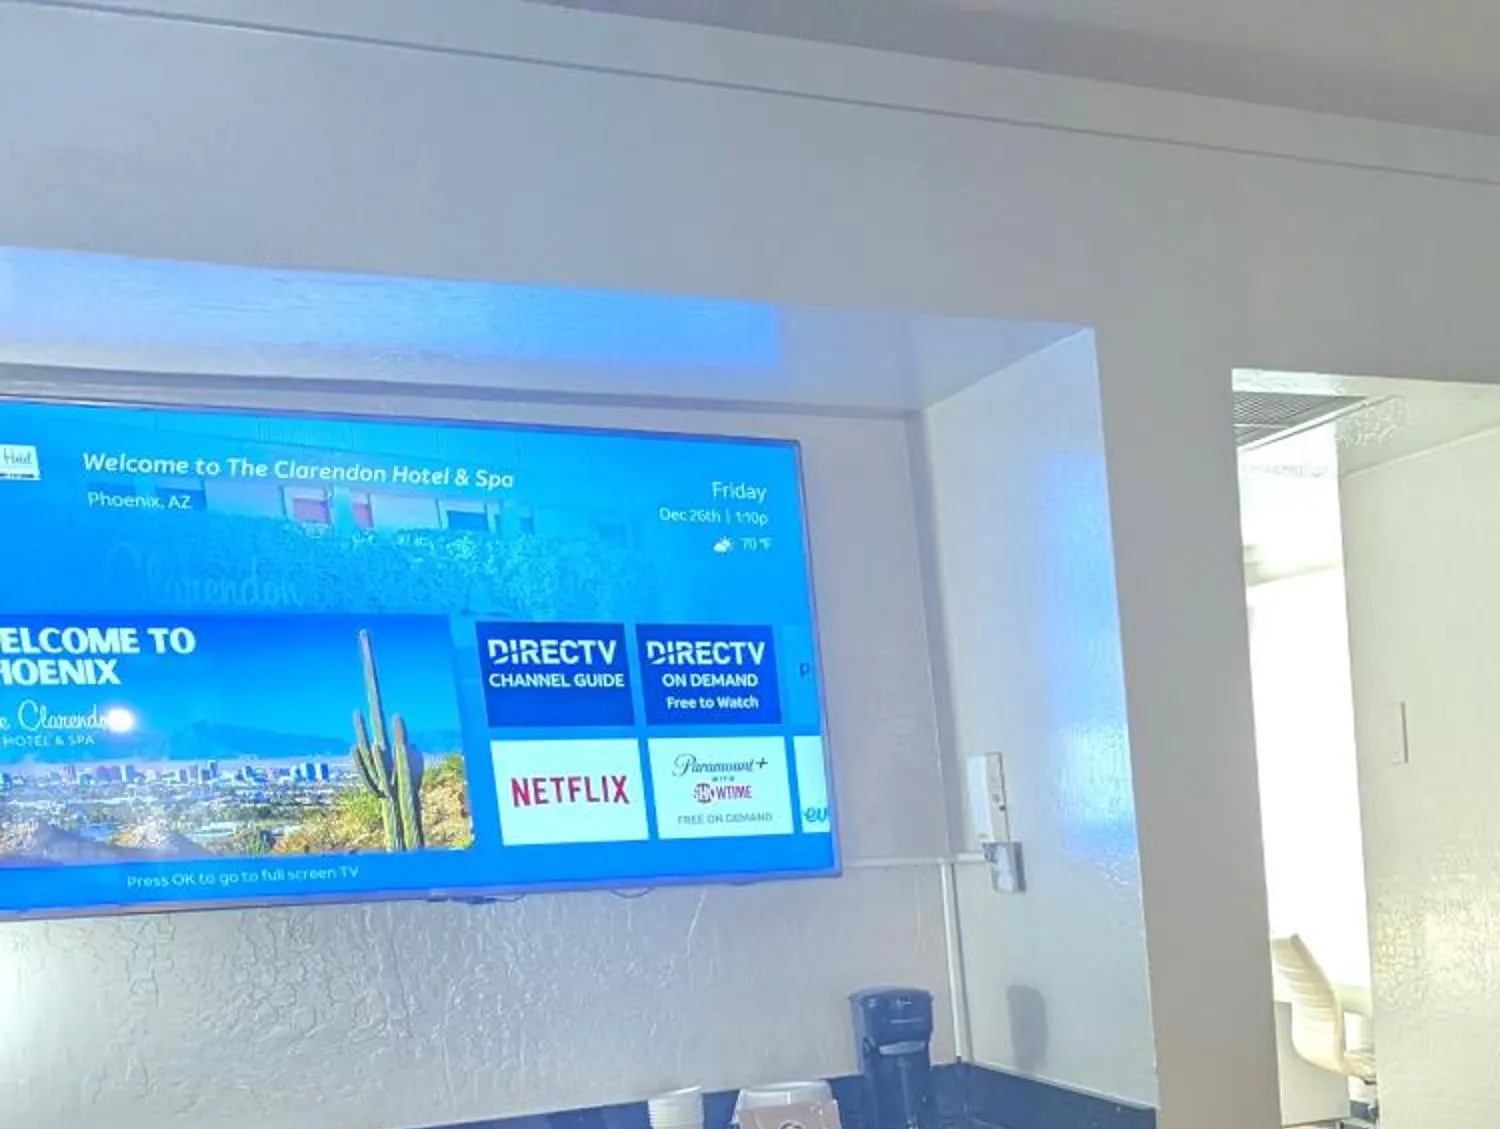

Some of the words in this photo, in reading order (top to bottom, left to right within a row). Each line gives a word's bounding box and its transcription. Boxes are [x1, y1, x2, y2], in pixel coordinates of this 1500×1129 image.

[83, 452, 189, 474] Welcome
[196, 457, 221, 476] to
[228, 458, 269, 477] The
[274, 460, 386, 483] Clarendon
[392, 466, 449, 485] Hotel
[454, 468, 469, 486] &
[475, 470, 513, 490] Spa
[87, 491, 165, 510] Phoenix,
[168, 495, 192, 509] AZ
[711, 481, 767, 505] Friday
[659, 507, 688, 521] Dec
[689, 509, 721, 523] 26th
[0, 626, 141, 655] ELCOME
[147, 626, 197, 655] TO
[487, 639, 617, 665] DIRECTV
[646, 640, 765, 666] DIRECTV
[488, 673, 571, 688] CHANNEL
[573, 673, 625, 688] GUIDE
[662, 673, 687, 687] ON
[690, 673, 759, 687] DEMAND
[667, 695, 697, 710] Free
[699, 695, 715, 709] to
[717, 694, 759, 709] Watch
[18, 698, 108, 731] Clarendo
[511, 775, 630, 807] NETFLIX
[677, 815, 704, 825] FREE
[707, 814, 723, 824] ON
[725, 812, 773, 823] DEMAND
[127, 875, 169, 888] Press
[172, 873, 196, 887] OK
[199, 873, 215, 885] to
[219, 873, 239, 887] go
[242, 871, 259, 883] to
[261, 868, 285, 882] full
[287, 869, 337, 882] screen
[339, 865, 360, 878] TV
